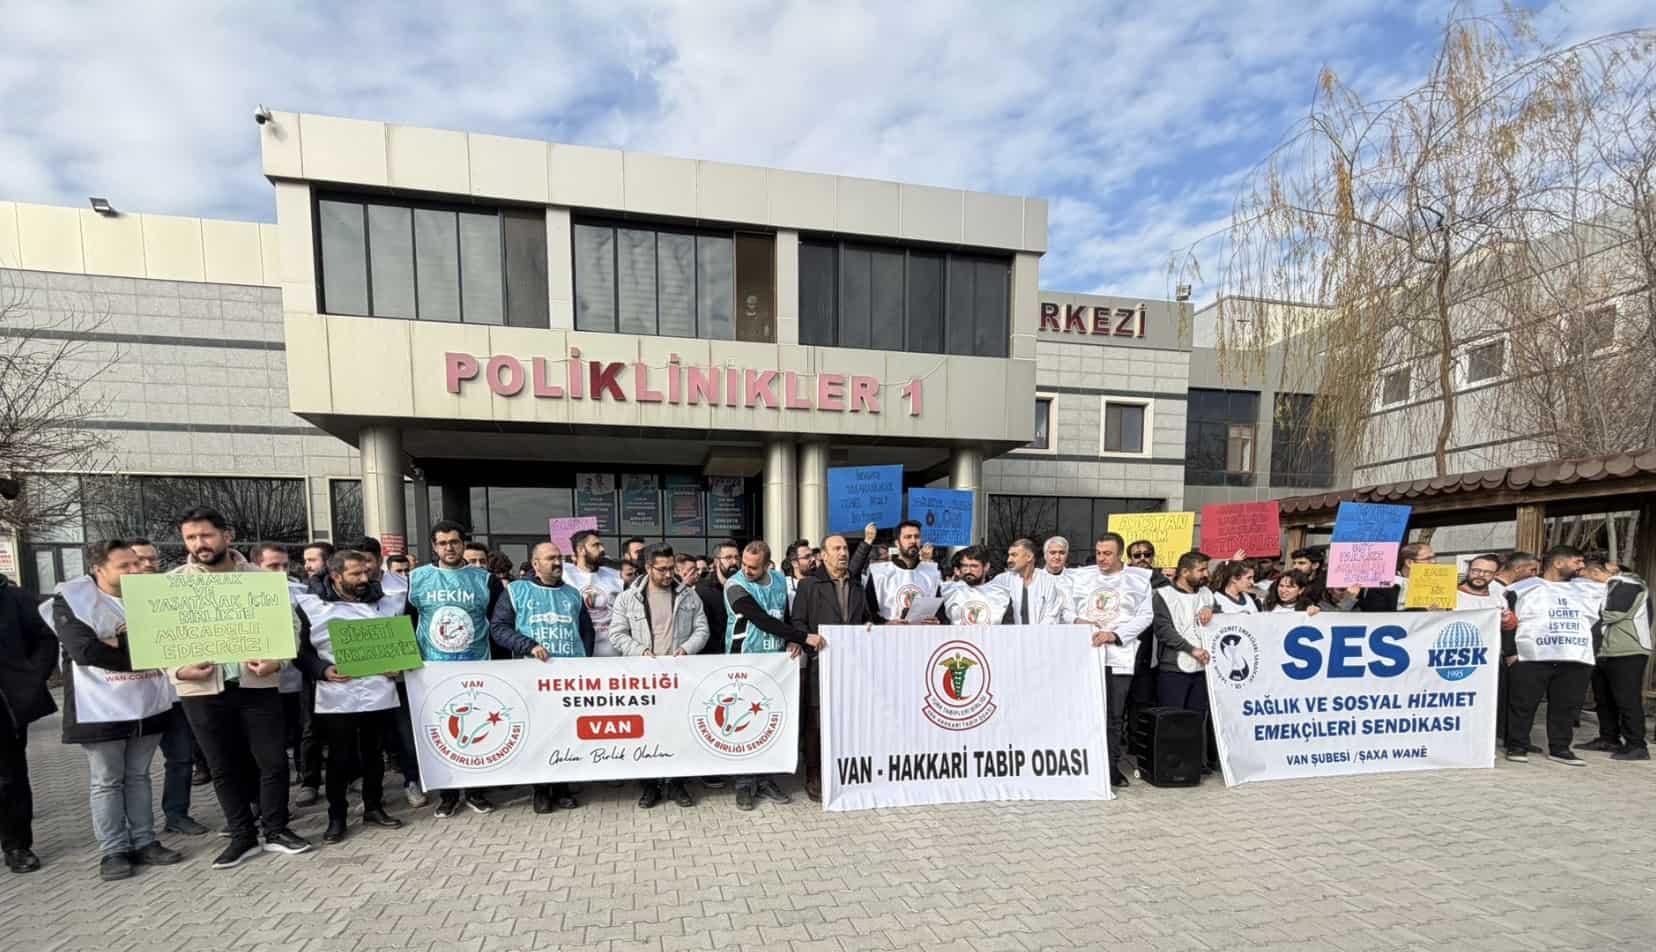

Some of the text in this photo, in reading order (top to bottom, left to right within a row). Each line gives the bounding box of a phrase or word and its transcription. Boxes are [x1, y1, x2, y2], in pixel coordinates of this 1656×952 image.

[900, 376, 923, 417] 1
[192, 586, 215, 598] VE
[426, 589, 475, 604] HEKİM
[532, 625, 574, 641] HEKİM
[1281, 625, 1411, 680] SES
[1427, 647, 1488, 667] KESK
[461, 680, 484, 689] VAN
[537, 673, 679, 692] HEKİM BİRLİĞİ
[727, 672, 748, 680] VAN
[562, 693, 656, 708] SENDİKASI
[1242, 689, 1477, 716] SAĞLIK VE SOSYAL HİZMET
[589, 720, 632, 735] VAN
[1254, 713, 1461, 742] EMEKÇİLERİ SENDİKASI
[837, 755, 873, 786] VAN
[888, 744, 968, 782] HAKKARİ
[973, 743, 1026, 778] TABİP
[1031, 748, 1089, 777] ODASI
[1286, 754, 1308, 766] VAN
[1311, 751, 1351, 768] ŞUBESİ
